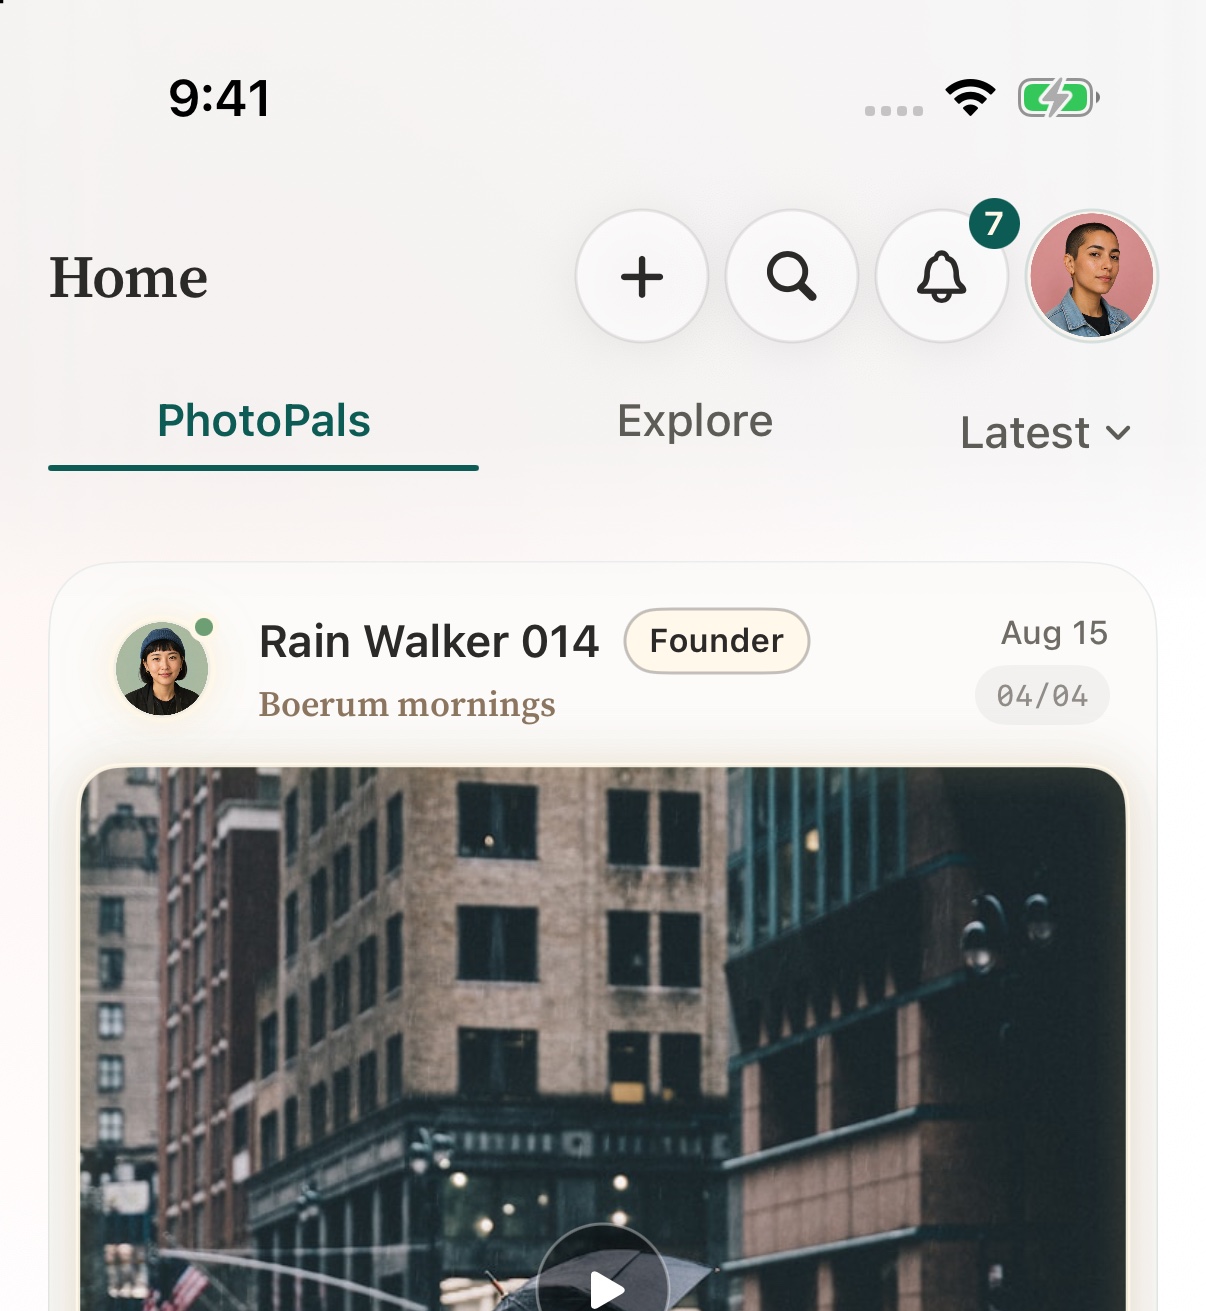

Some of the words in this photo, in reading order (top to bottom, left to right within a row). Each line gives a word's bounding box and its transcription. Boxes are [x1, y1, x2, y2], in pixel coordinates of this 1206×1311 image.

[169, 79, 269, 117] 9:41
[985, 212, 1003, 235] 7
[50, 257, 207, 298] Home
[160, 402, 370, 437] PhotoPals
[620, 403, 772, 444] Explore
[963, 416, 1089, 449] Latest
[262, 622, 349, 658] Rain
[364, 623, 509, 658] Walker
[523, 624, 599, 658] 014
[652, 627, 784, 653] Founder
[1001, 620, 1060, 650] Aug
[1074, 621, 1107, 645] 15
[259, 692, 389, 717] Boerum
[398, 690, 555, 725] mornings
[998, 682, 1088, 709] 04/04
